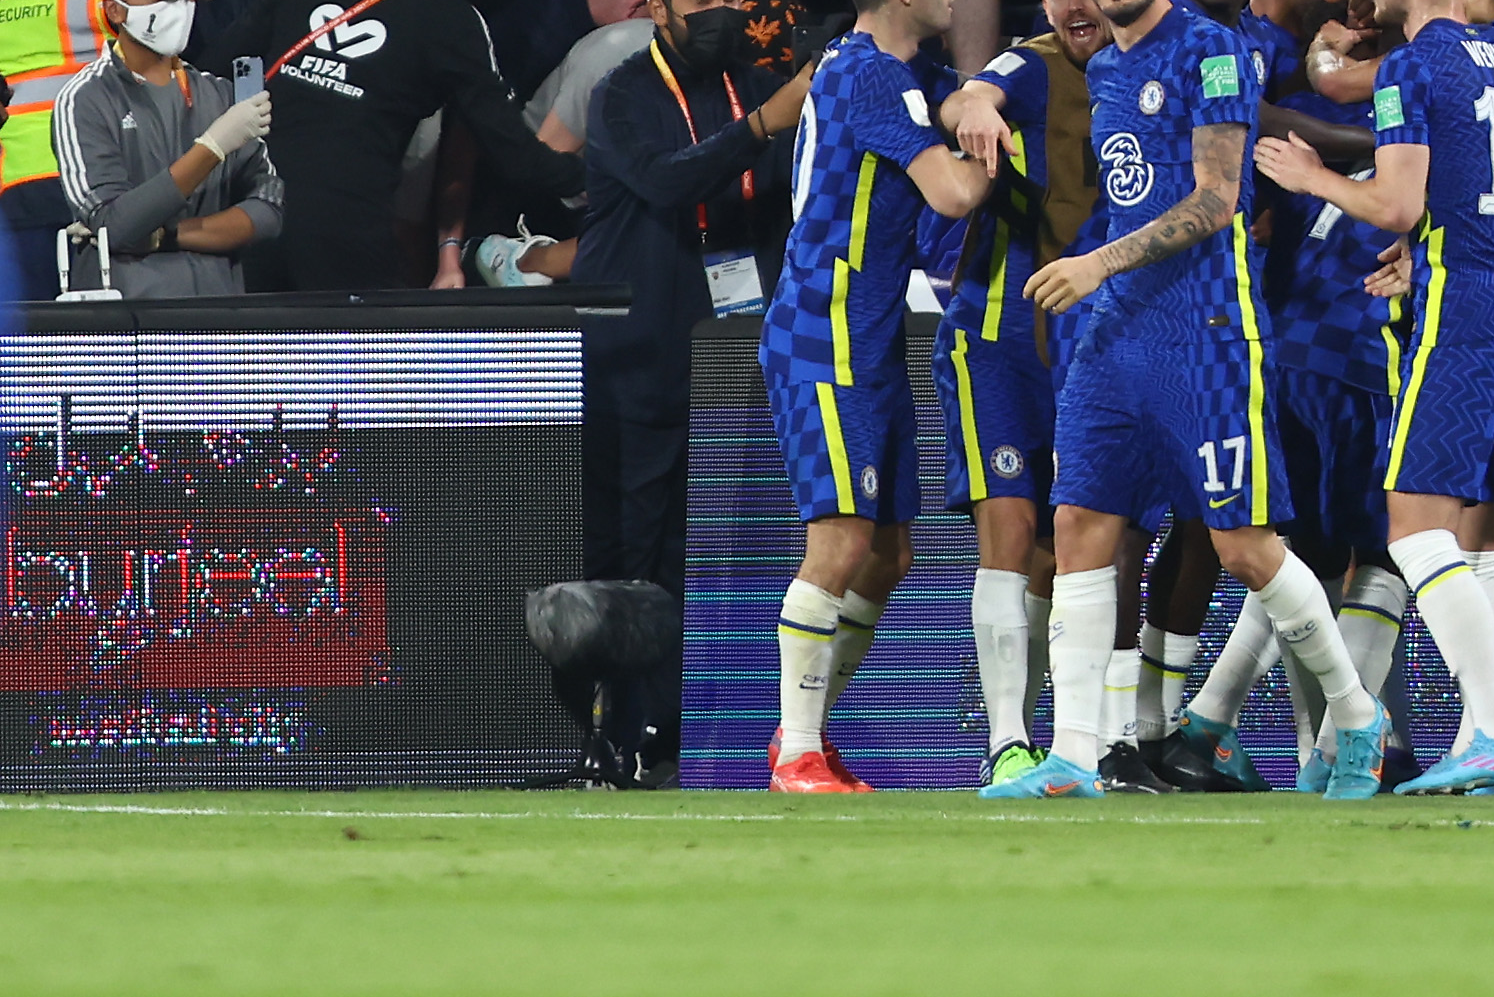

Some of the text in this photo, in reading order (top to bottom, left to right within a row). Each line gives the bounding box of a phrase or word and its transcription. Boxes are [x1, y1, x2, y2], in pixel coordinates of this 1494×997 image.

[0, 4, 53, 23] ECURITY
[280, 64, 364, 98] VOLUNTEER
[301, 55, 347, 81] FIFA
[1197, 435, 1246, 492] 17
